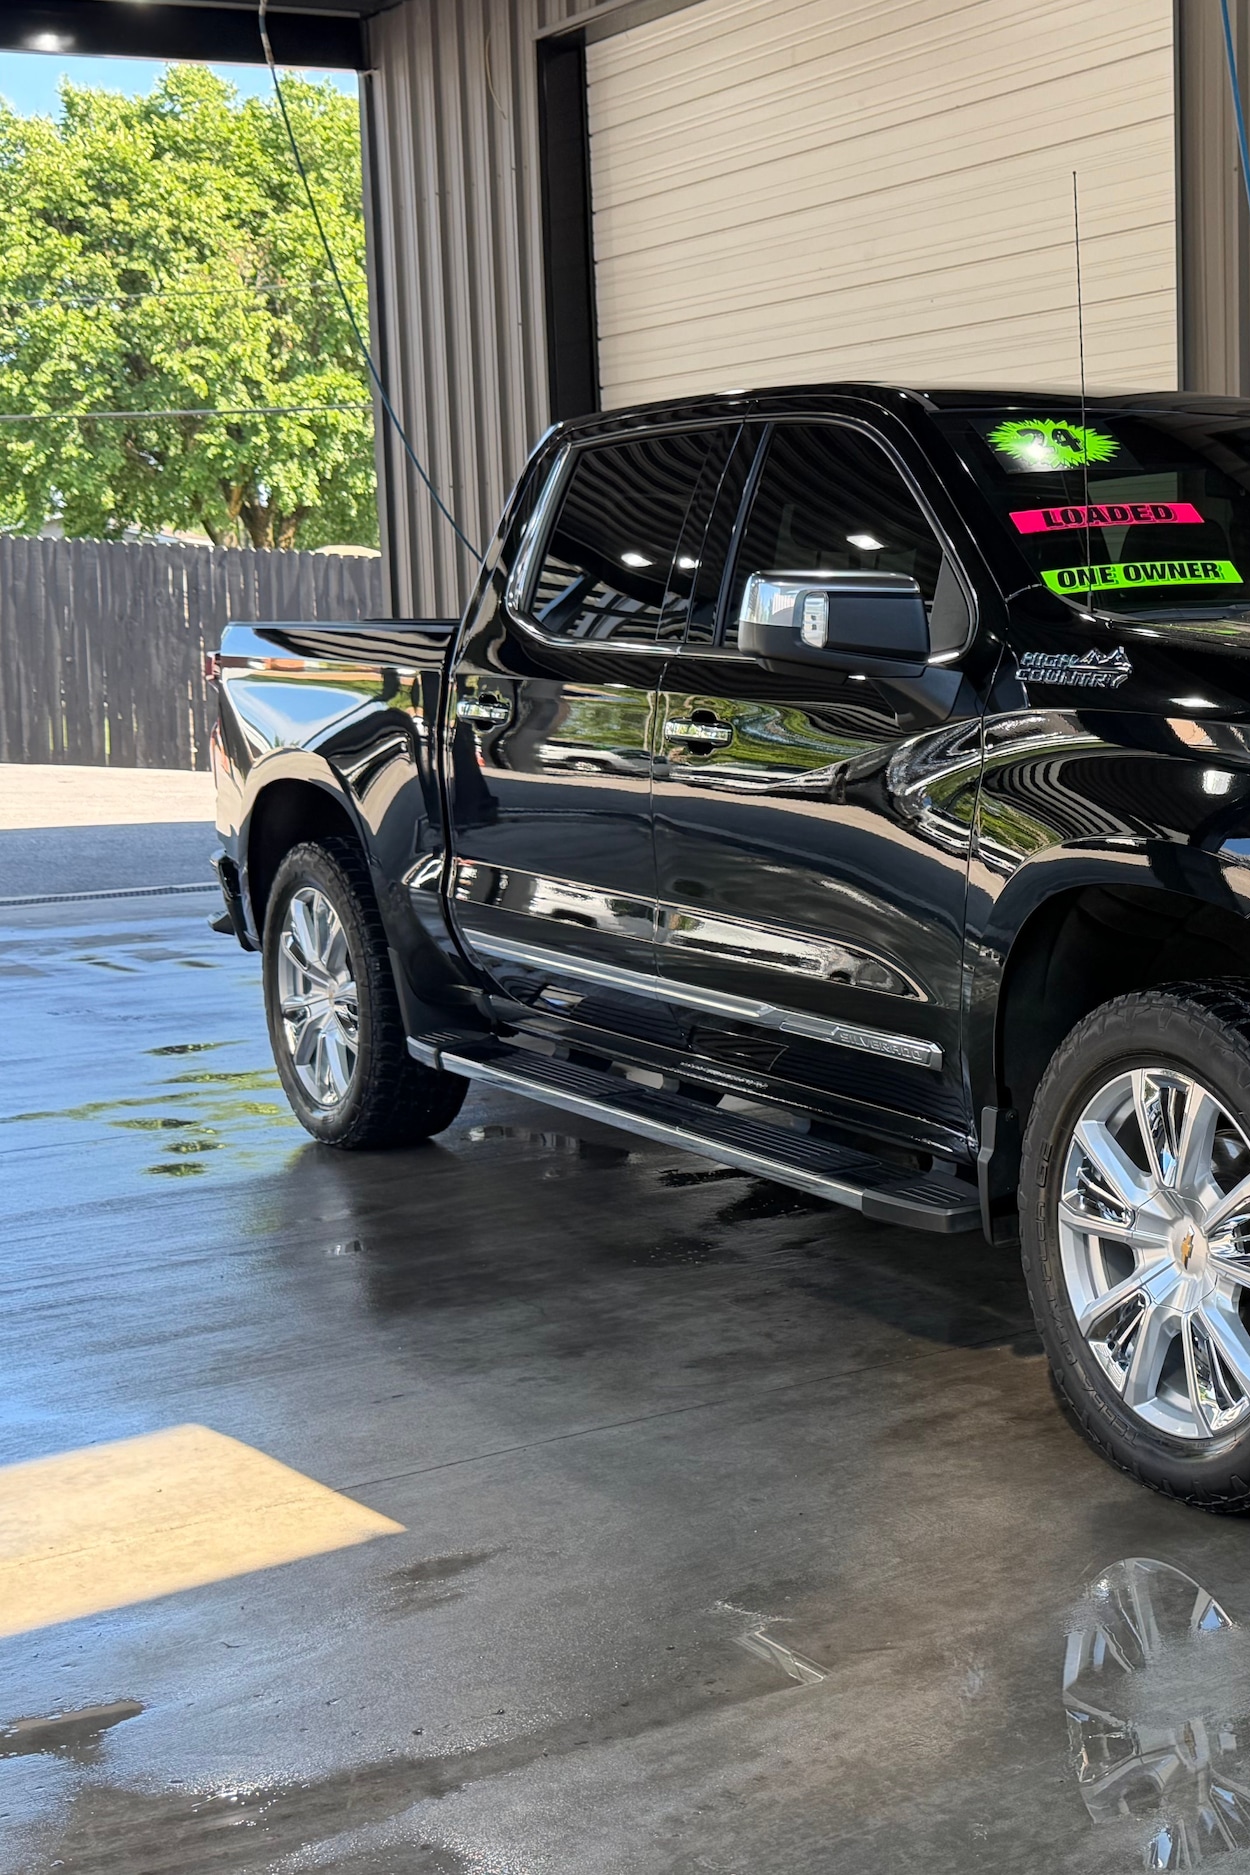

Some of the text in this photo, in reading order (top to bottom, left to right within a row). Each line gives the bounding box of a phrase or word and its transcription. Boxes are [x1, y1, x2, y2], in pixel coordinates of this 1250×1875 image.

[1042, 504, 1177, 529] LOADED
[1057, 562, 1225, 589] ONE OWNER
[1020, 651, 1080, 668] HIGH
[1015, 668, 1128, 688] COUNTRY
[840, 1033, 923, 1061] SILVERADO
